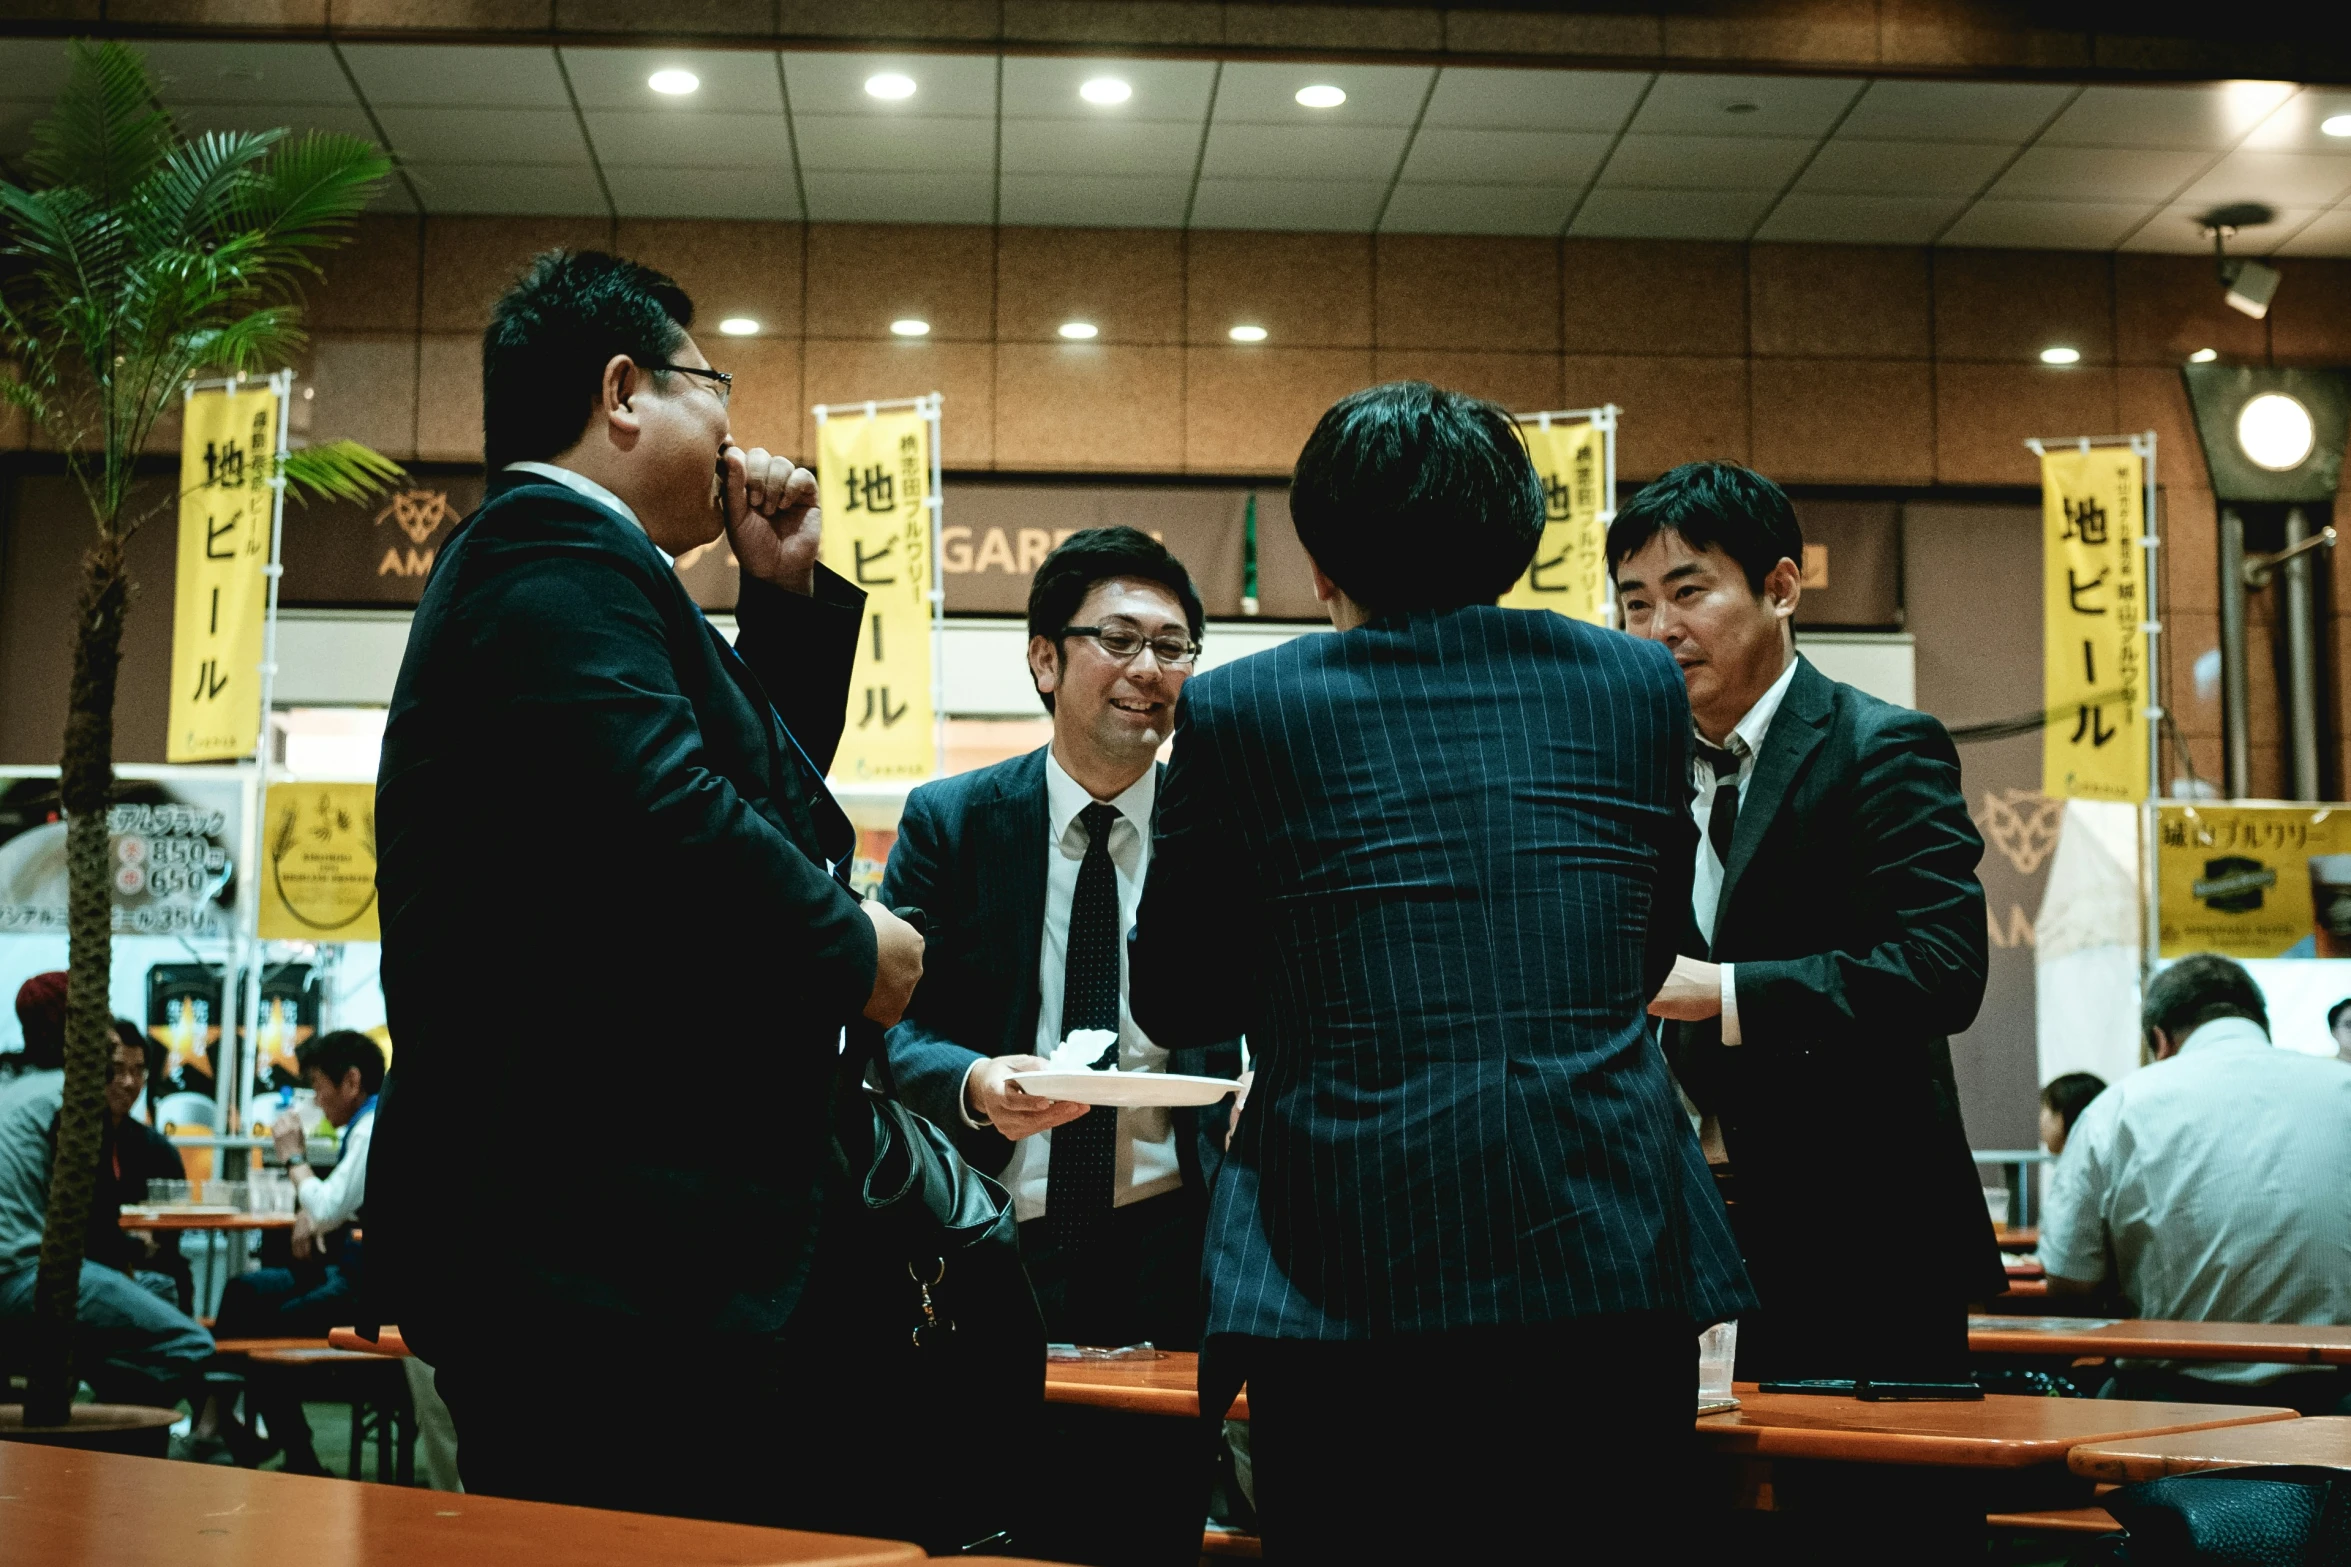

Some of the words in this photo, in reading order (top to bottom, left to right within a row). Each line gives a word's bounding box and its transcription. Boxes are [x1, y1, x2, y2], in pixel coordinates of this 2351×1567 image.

[193, 440, 245, 702] 地ビール
[845, 463, 908, 731] 地ビール
[2063, 496, 2116, 748] 地ビール
[2163, 818, 2327, 850] 城山ブルワリー
